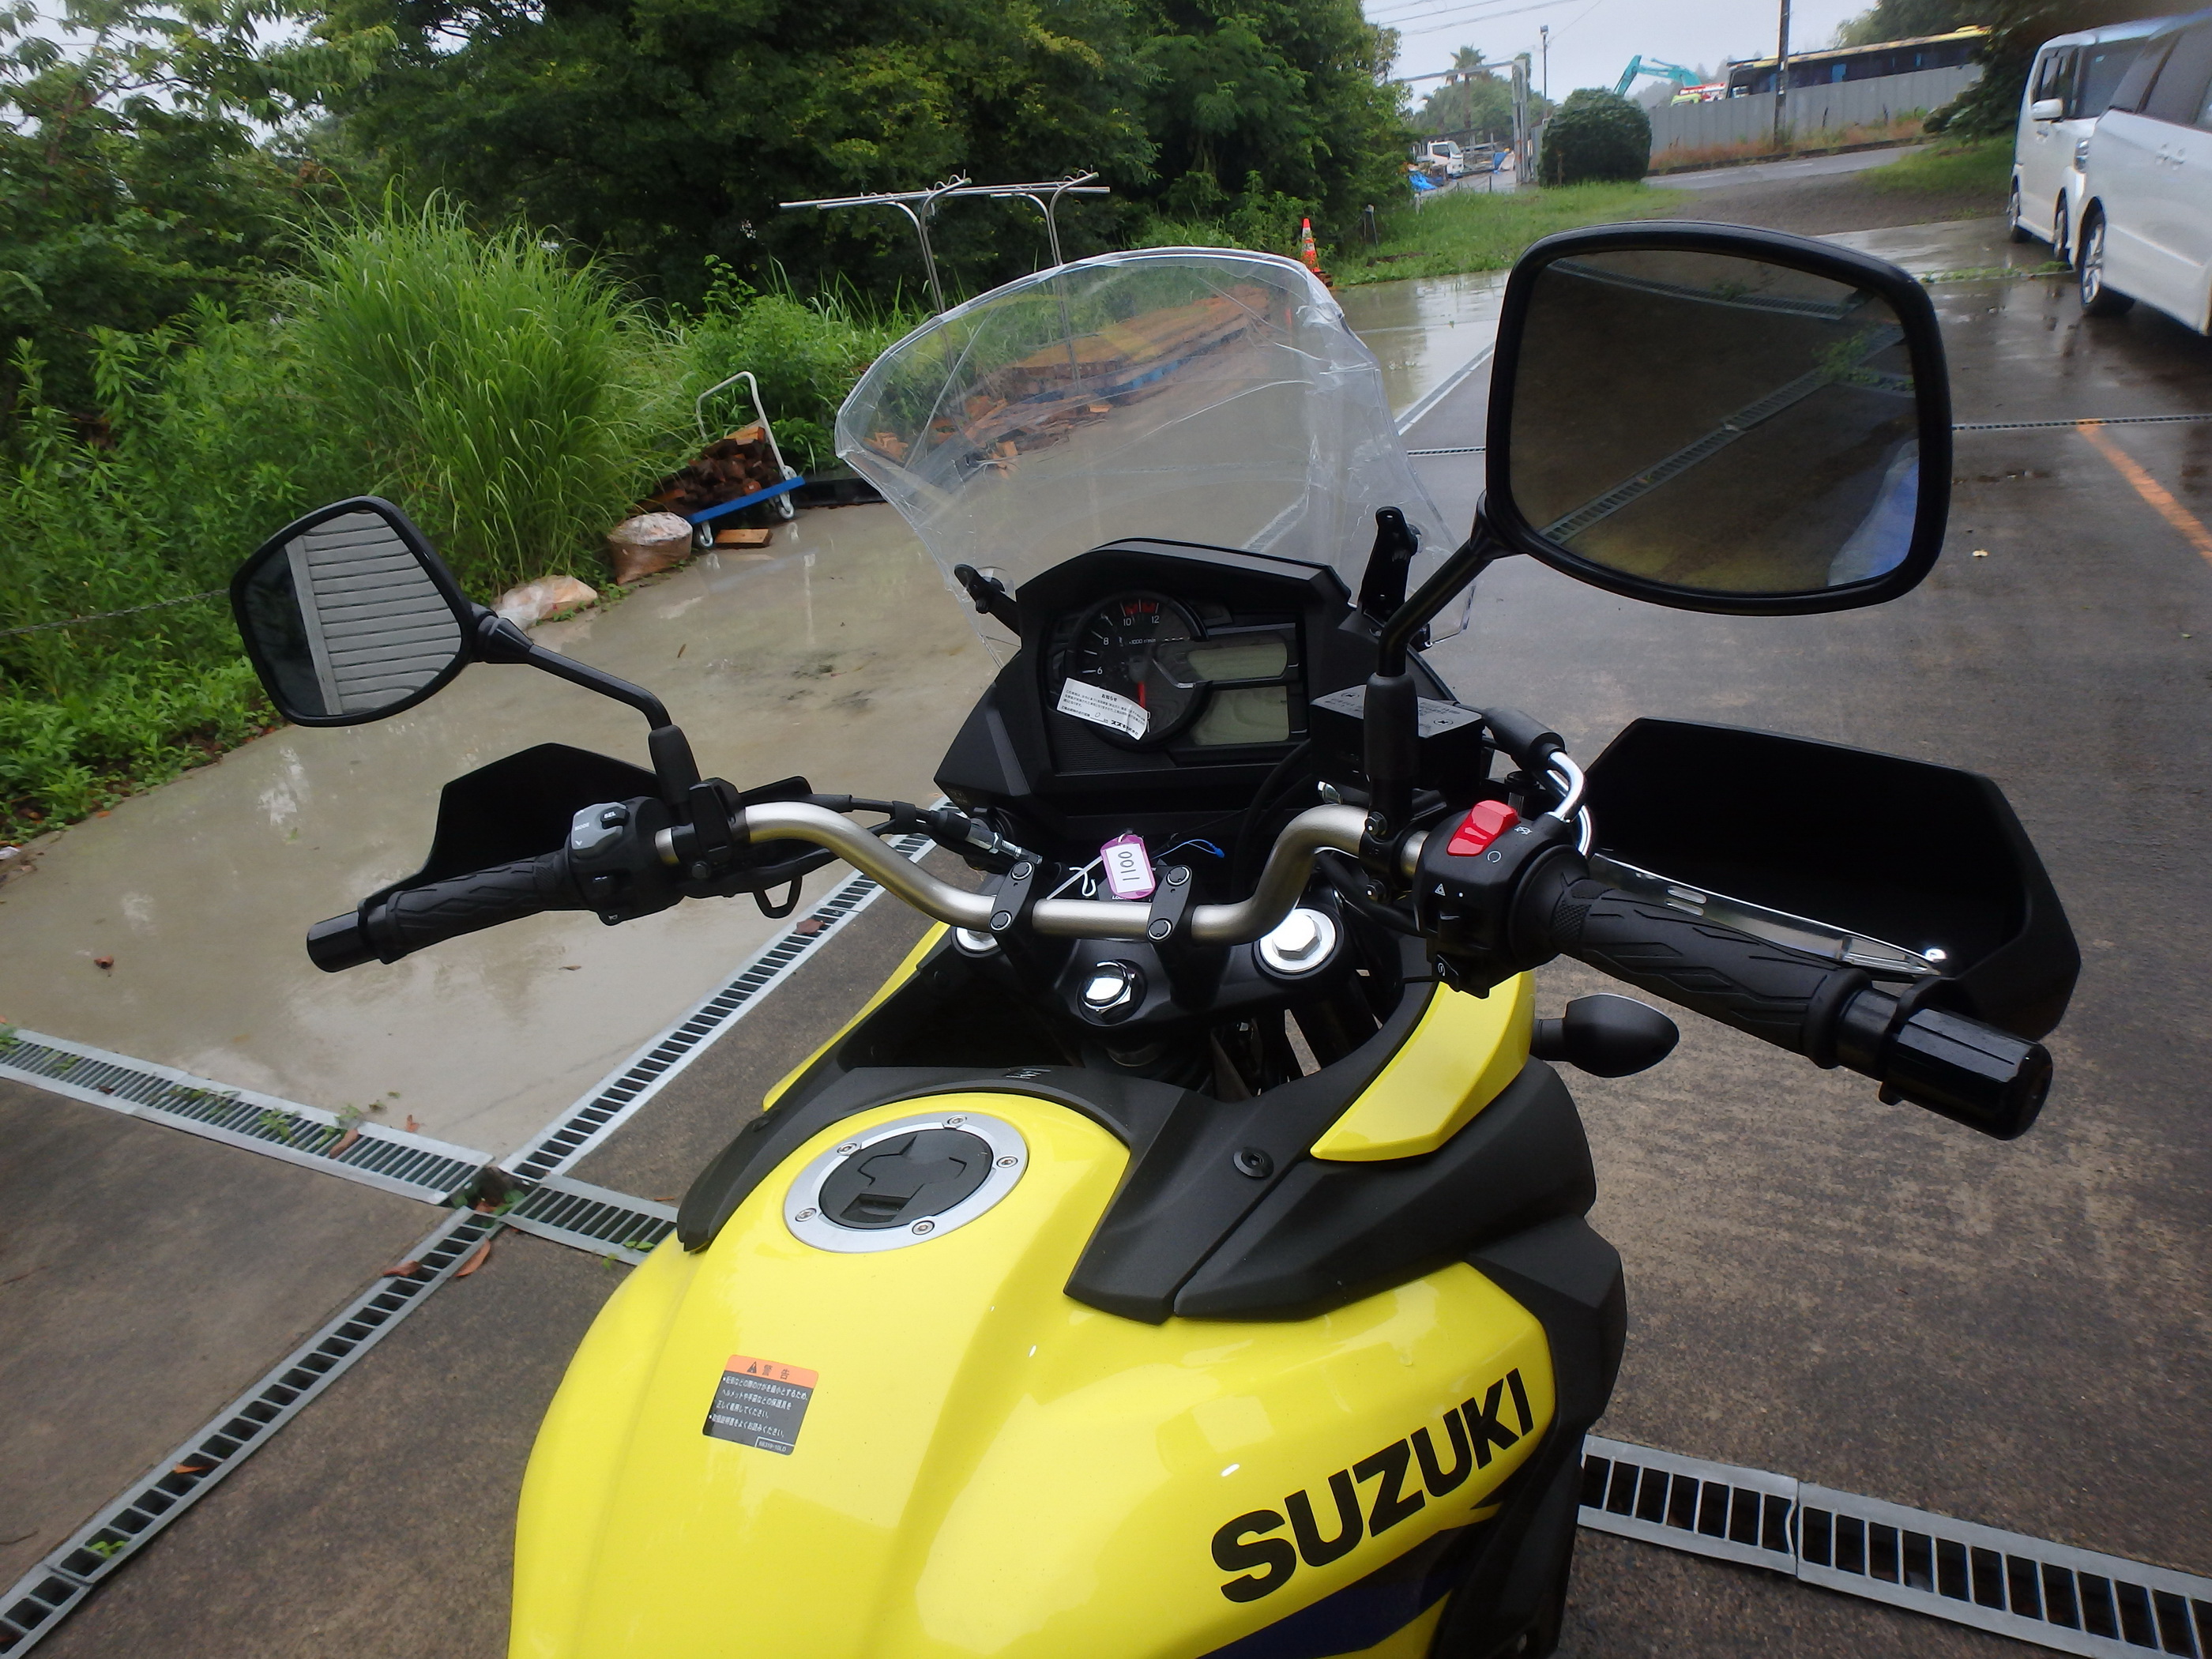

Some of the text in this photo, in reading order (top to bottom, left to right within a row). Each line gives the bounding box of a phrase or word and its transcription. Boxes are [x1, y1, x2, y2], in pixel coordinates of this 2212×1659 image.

[1123, 618, 1132, 626] 10
[1151, 615, 1160, 624] 12
[1103, 637, 1109, 645] 8
[1211, 1367, 1534, 1603] SUZUKI
